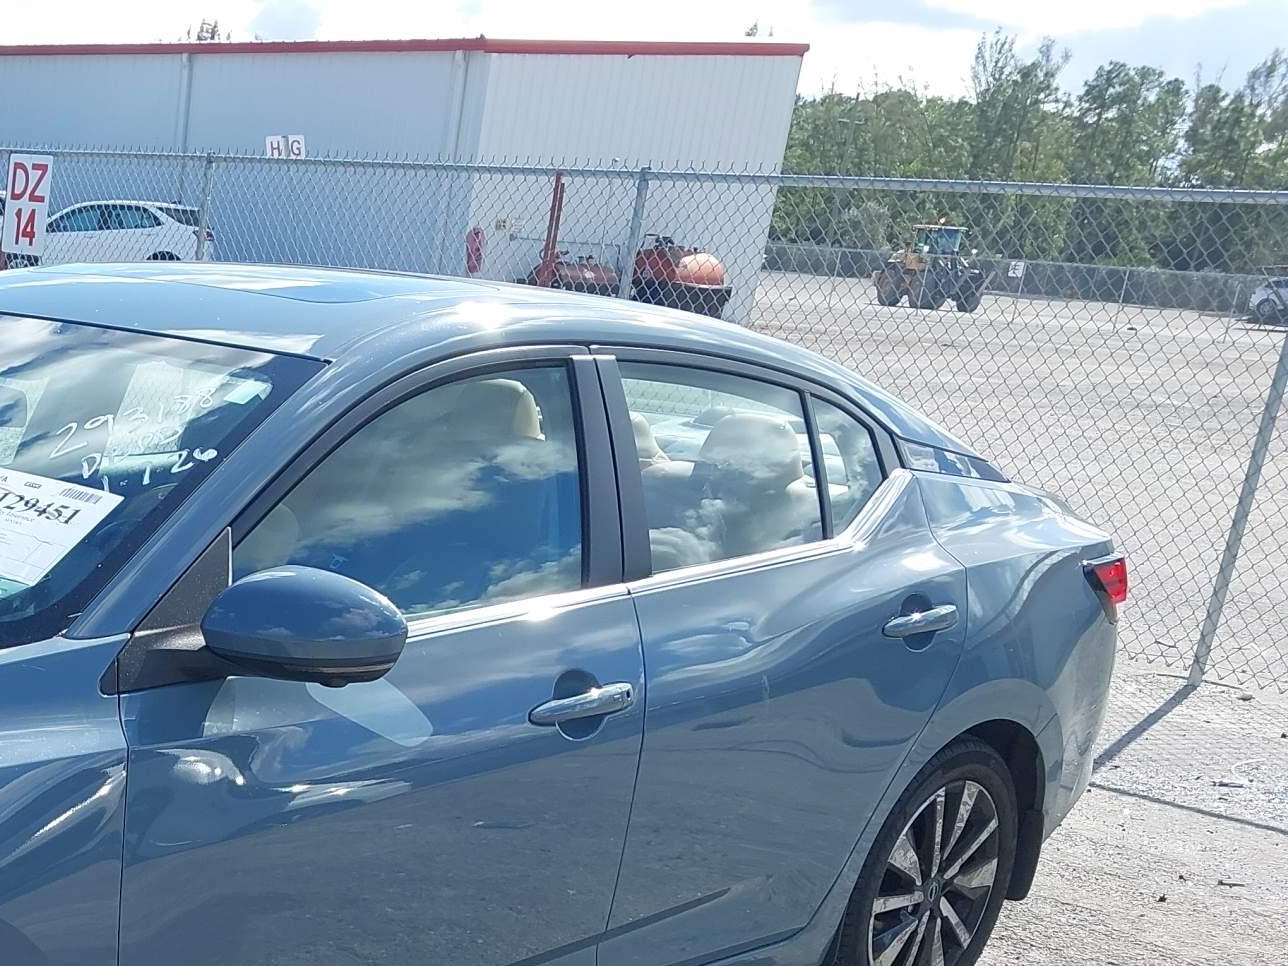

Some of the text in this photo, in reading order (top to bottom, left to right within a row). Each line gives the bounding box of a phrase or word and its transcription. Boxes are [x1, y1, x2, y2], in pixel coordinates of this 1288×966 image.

[270, 140, 281, 157] H
[290, 139, 302, 156] G
[10, 161, 49, 203] DZ
[14, 207, 37, 247] 14
